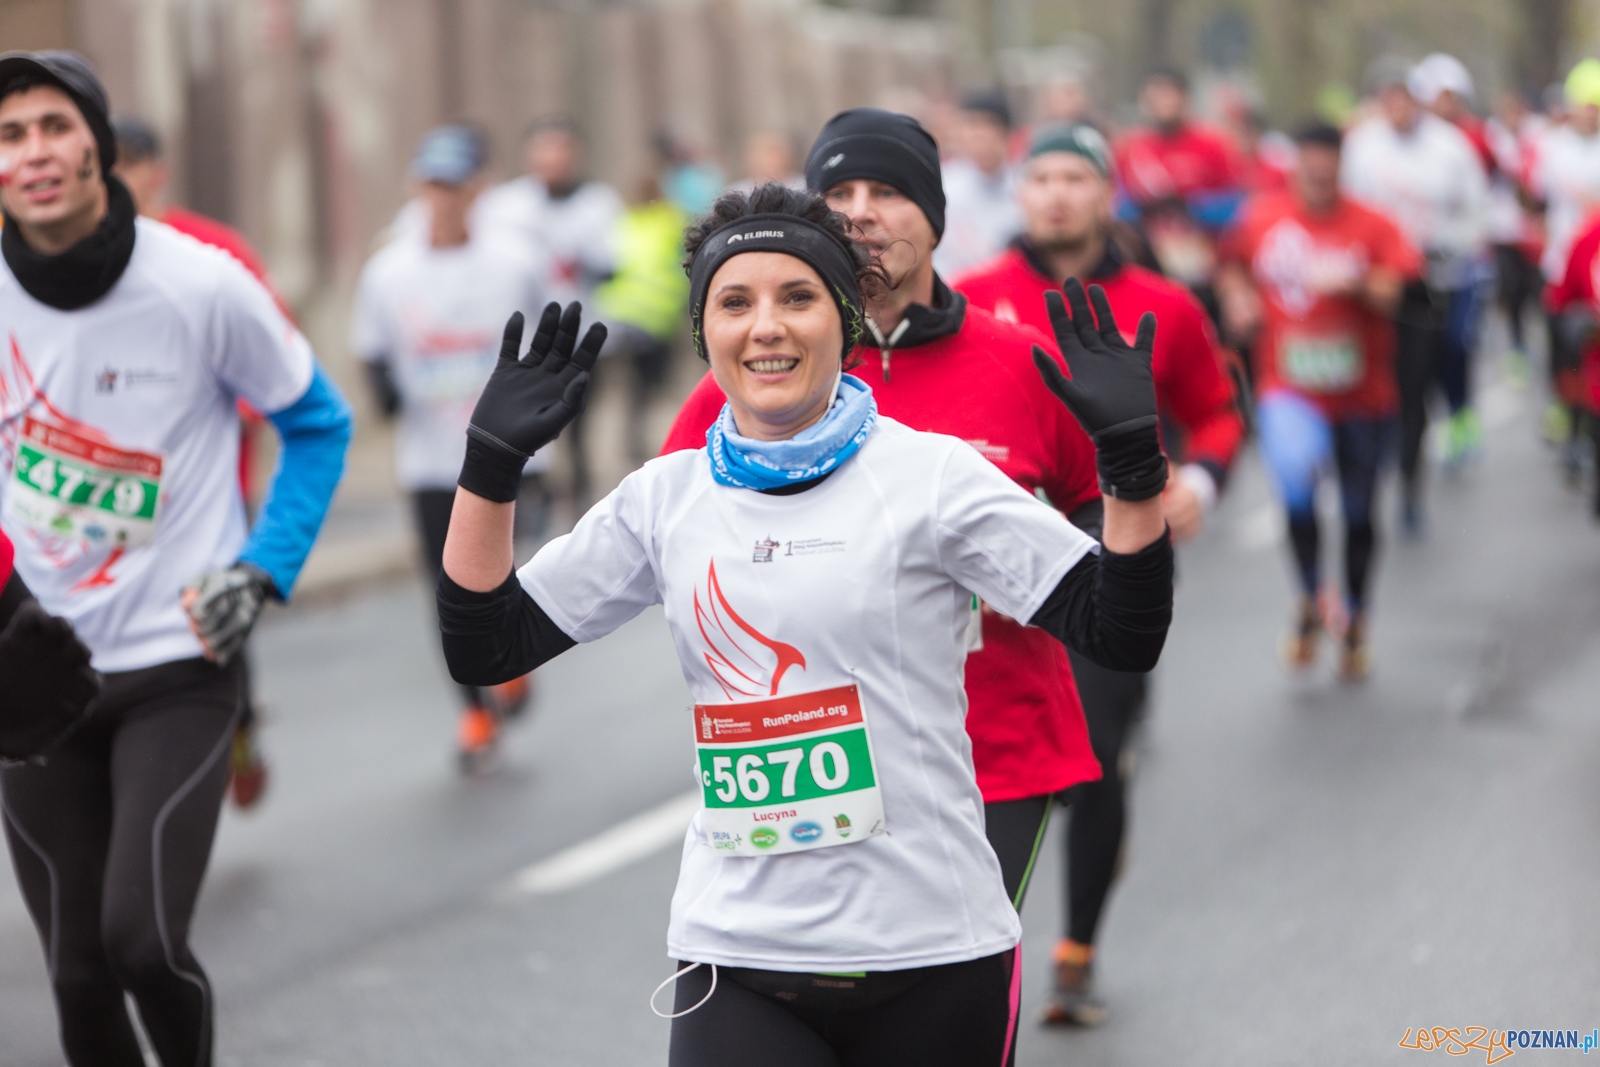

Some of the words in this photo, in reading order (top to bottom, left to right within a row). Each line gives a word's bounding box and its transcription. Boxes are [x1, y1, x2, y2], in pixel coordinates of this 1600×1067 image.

[743, 230, 785, 240] ELBRUS
[28, 458, 145, 516] 4779
[762, 704, 848, 728] RunPoland.org
[712, 741, 850, 804] 5670
[753, 808, 797, 823] Lucyna
